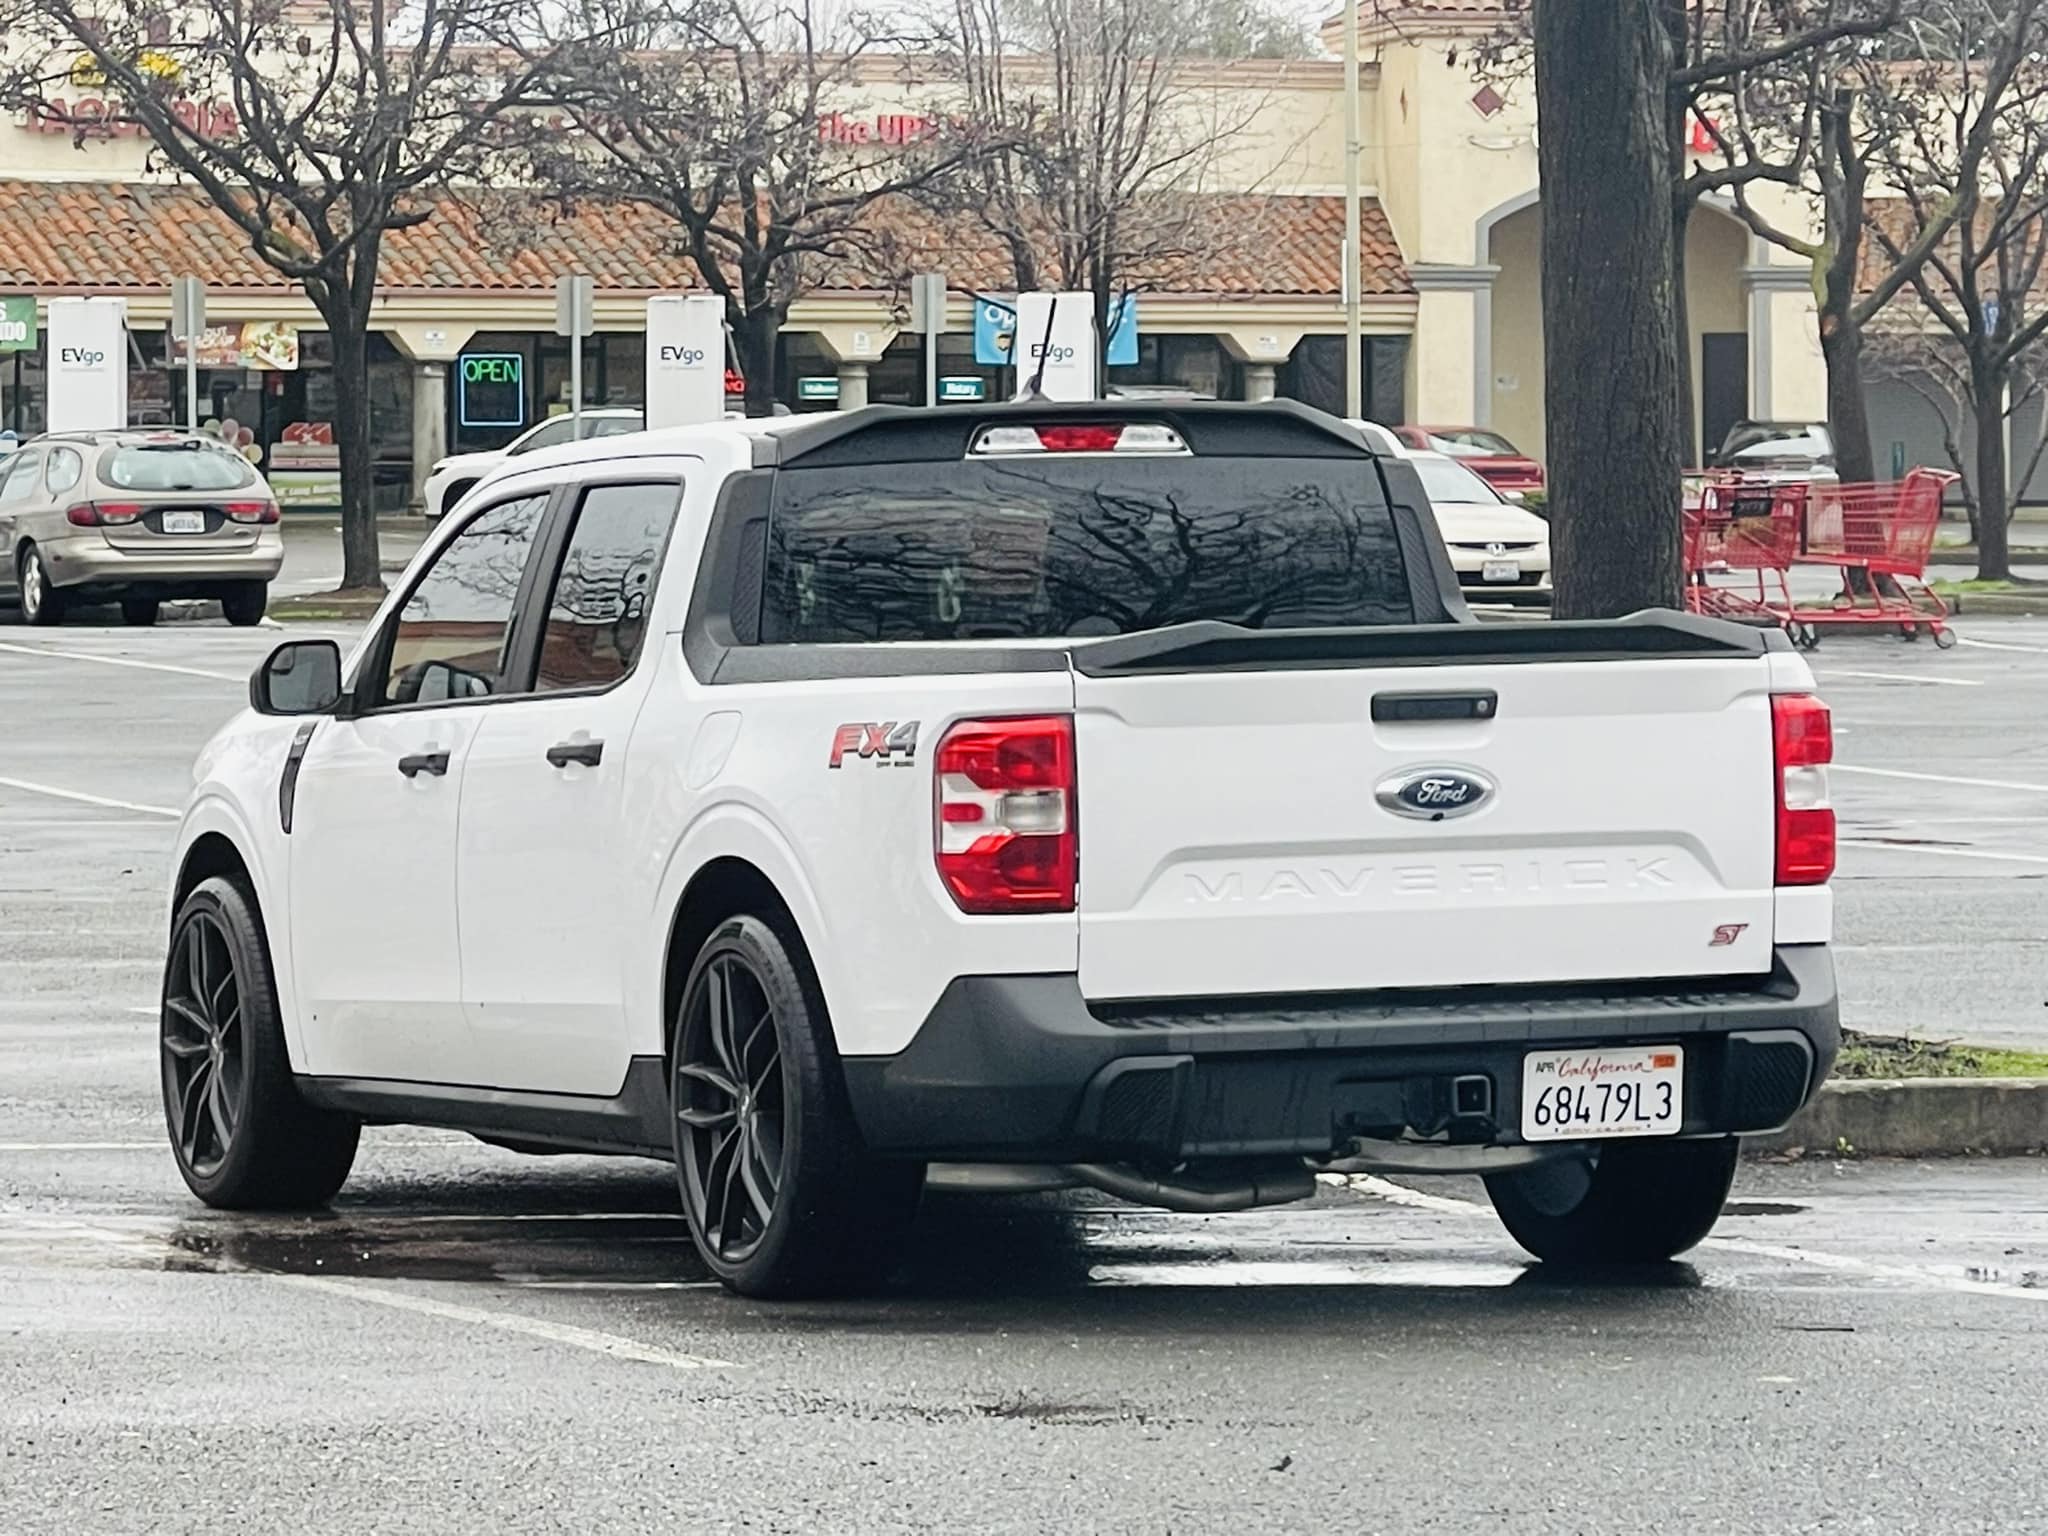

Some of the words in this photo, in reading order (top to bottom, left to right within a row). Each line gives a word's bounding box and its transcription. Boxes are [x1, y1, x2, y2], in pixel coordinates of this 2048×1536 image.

[818, 111, 870, 145] The
[61, 347, 104, 366] EVgo
[660, 346, 705, 365] EVgo
[464, 360, 518, 383] OPEN
[829, 720, 921, 769] FX4
[1417, 778, 1468, 803] Ford
[1183, 857, 1674, 903] MAVERICK
[1708, 922, 1749, 947] ST
[1535, 1061, 1555, 1073] APR
[1558, 1056, 1653, 1082] California
[1534, 1081, 1673, 1126] 68479L3
